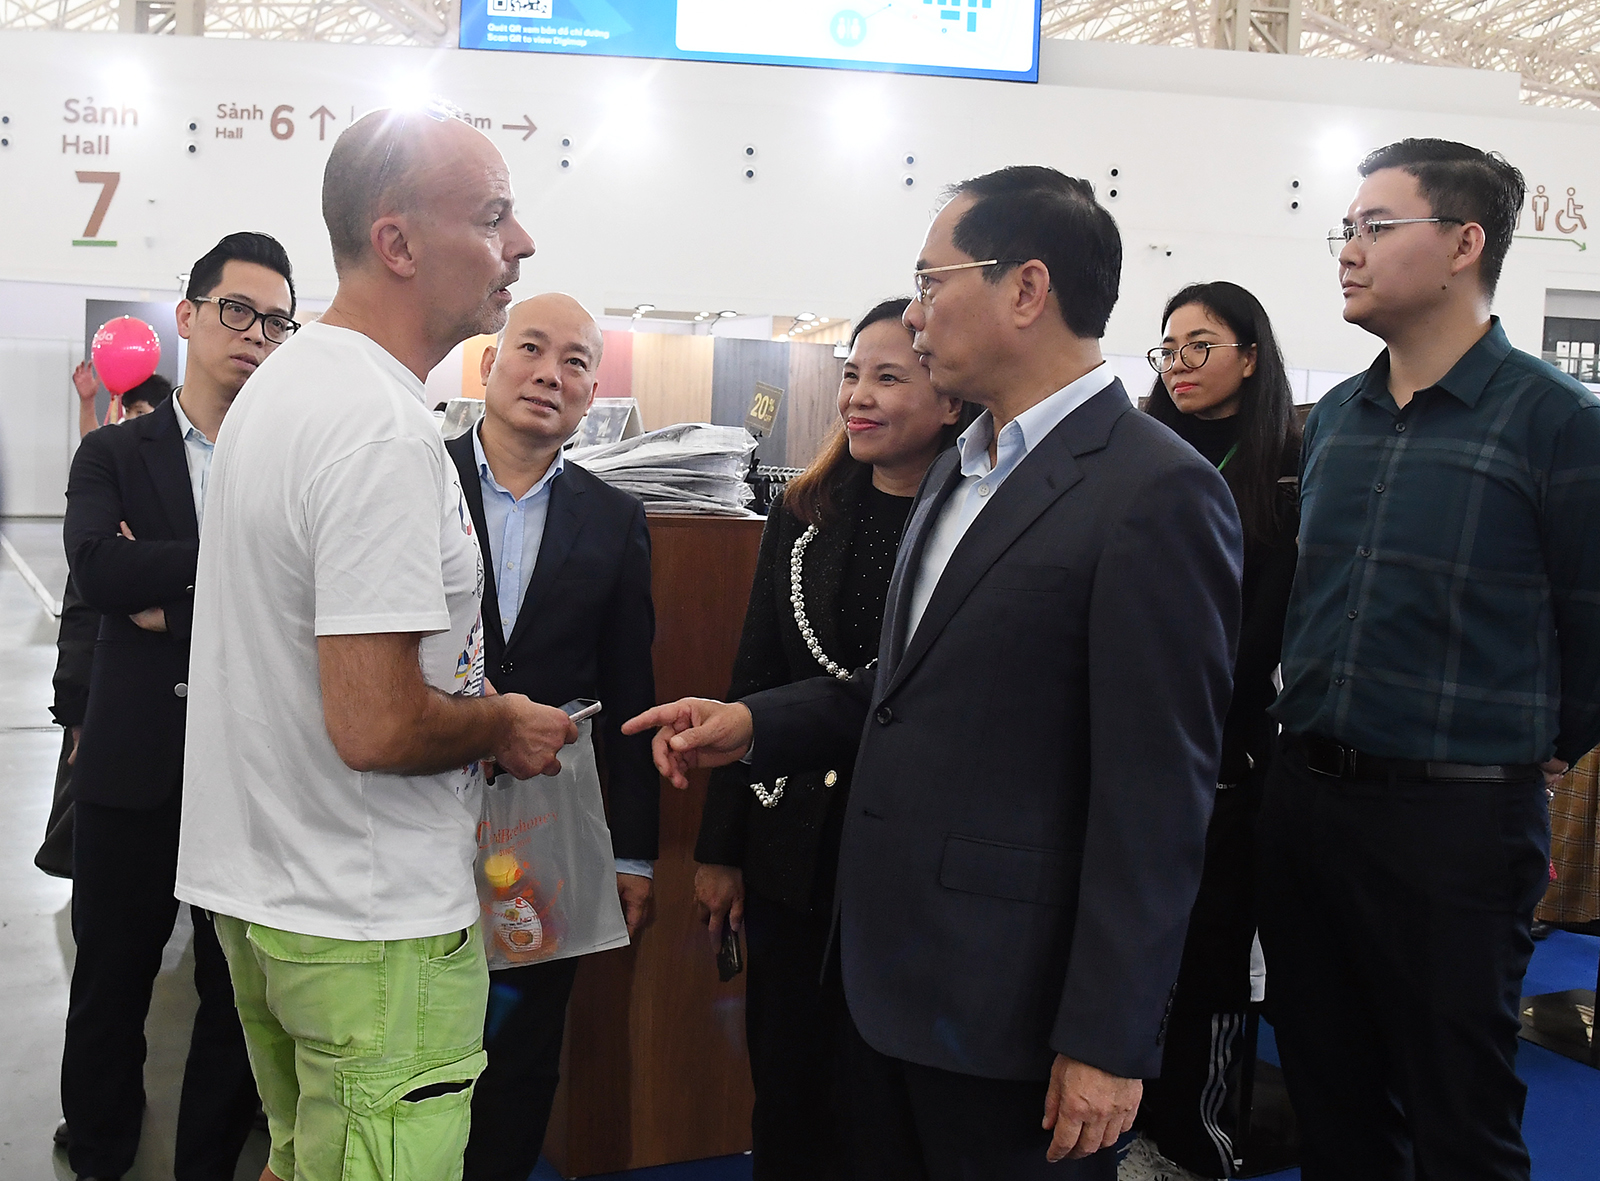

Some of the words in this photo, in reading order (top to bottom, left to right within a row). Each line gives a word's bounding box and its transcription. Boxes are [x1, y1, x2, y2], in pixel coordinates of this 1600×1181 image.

[509, 24, 522, 33] QR
[487, 32, 508, 42] Scan
[509, 34, 522, 42] QR
[523, 35, 533, 43] to
[533, 35, 552, 45] view
[553, 36, 587, 48] Digimap
[63, 96, 138, 126] Sảnh
[216, 102, 264, 120] Sảnh
[270, 104, 295, 141] 6
[456, 112, 492, 130] âm
[215, 127, 243, 140] Hall
[62, 135, 110, 155] Hall
[75, 170, 121, 238] 7
